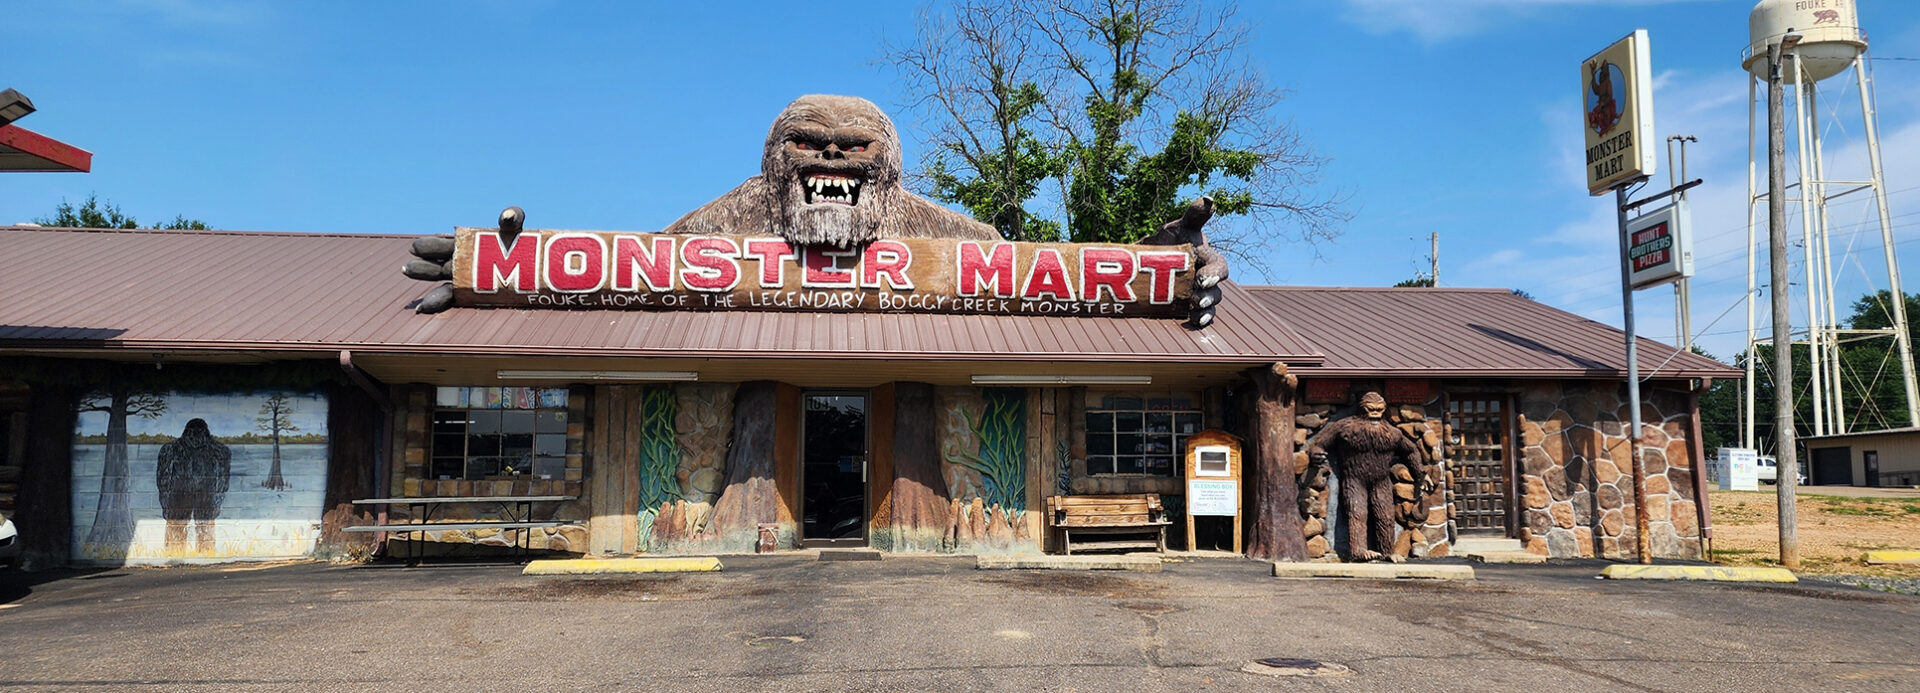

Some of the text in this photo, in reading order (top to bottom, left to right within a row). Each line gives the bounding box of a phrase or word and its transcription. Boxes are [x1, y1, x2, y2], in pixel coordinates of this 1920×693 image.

[1586, 131, 1632, 165] MONSTER
[1595, 154, 1624, 181] MART
[1631, 235, 1671, 260] BROTHERS
[1638, 226, 1660, 245] HUNT
[472, 232, 1190, 305] MONSTER MART
[1639, 249, 1663, 268] PIZZA
[601, 294, 654, 306] HOME
[662, 294, 689, 306] OF
[701, 294, 738, 308] THE
[750, 290, 866, 309] LEGENDARY
[878, 291, 945, 310] BOGGY
[952, 298, 1010, 313] CREEK
[1021, 301, 1126, 315] MONSTER
